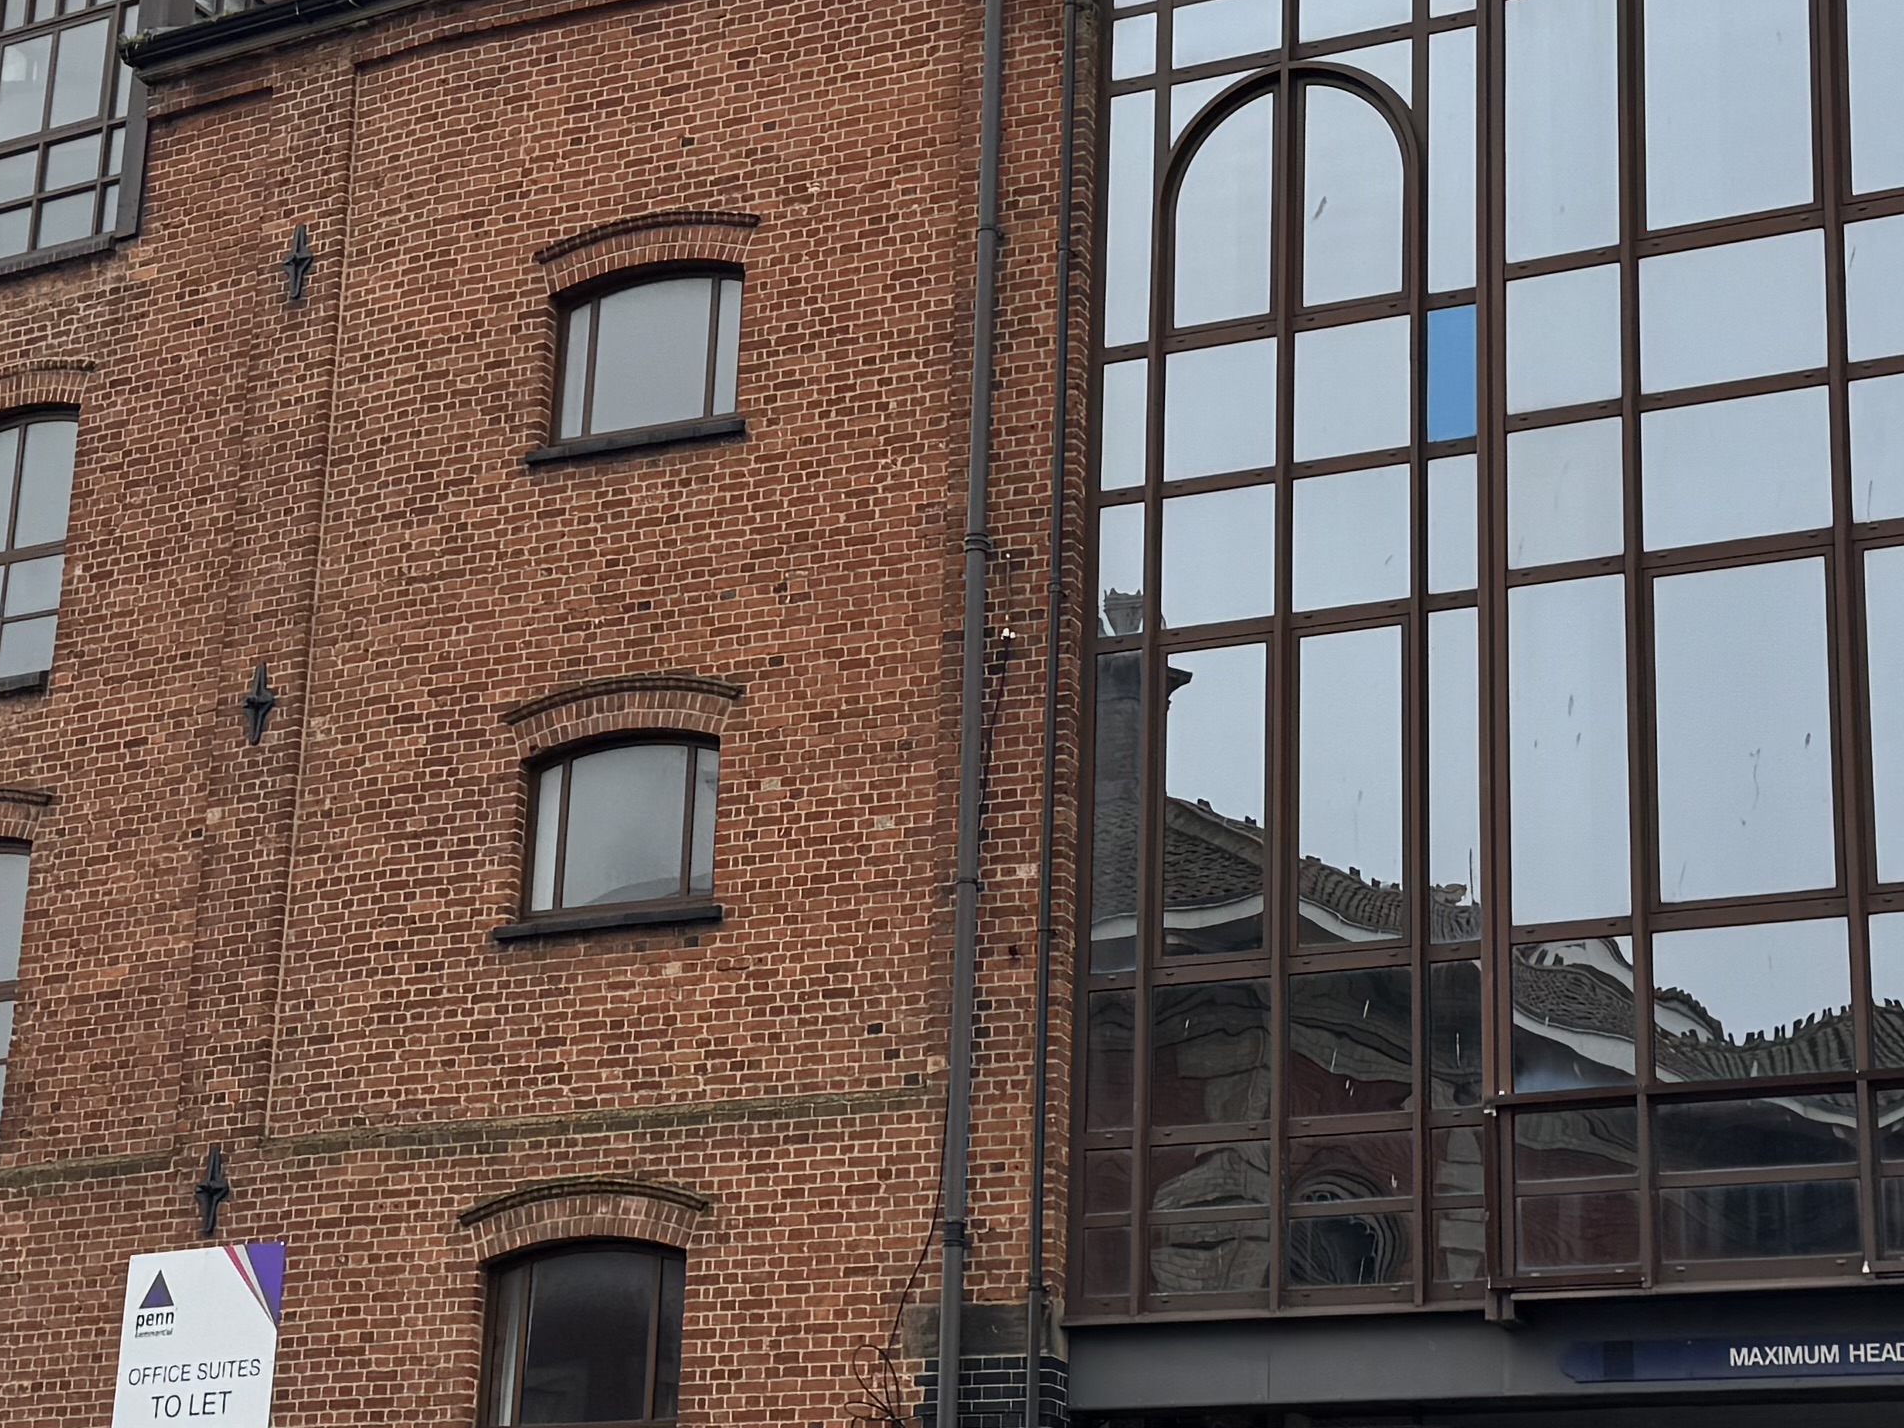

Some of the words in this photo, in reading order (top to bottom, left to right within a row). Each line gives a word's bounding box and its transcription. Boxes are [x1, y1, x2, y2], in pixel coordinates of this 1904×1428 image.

[135, 1312, 175, 1333] penn
[1729, 1344, 1840, 1366] MAXIMUM
[128, 1363, 192, 1386] OFFICE
[197, 1358, 262, 1380] SUITES
[151, 1394, 182, 1419] TO
[188, 1390, 233, 1417] LET
